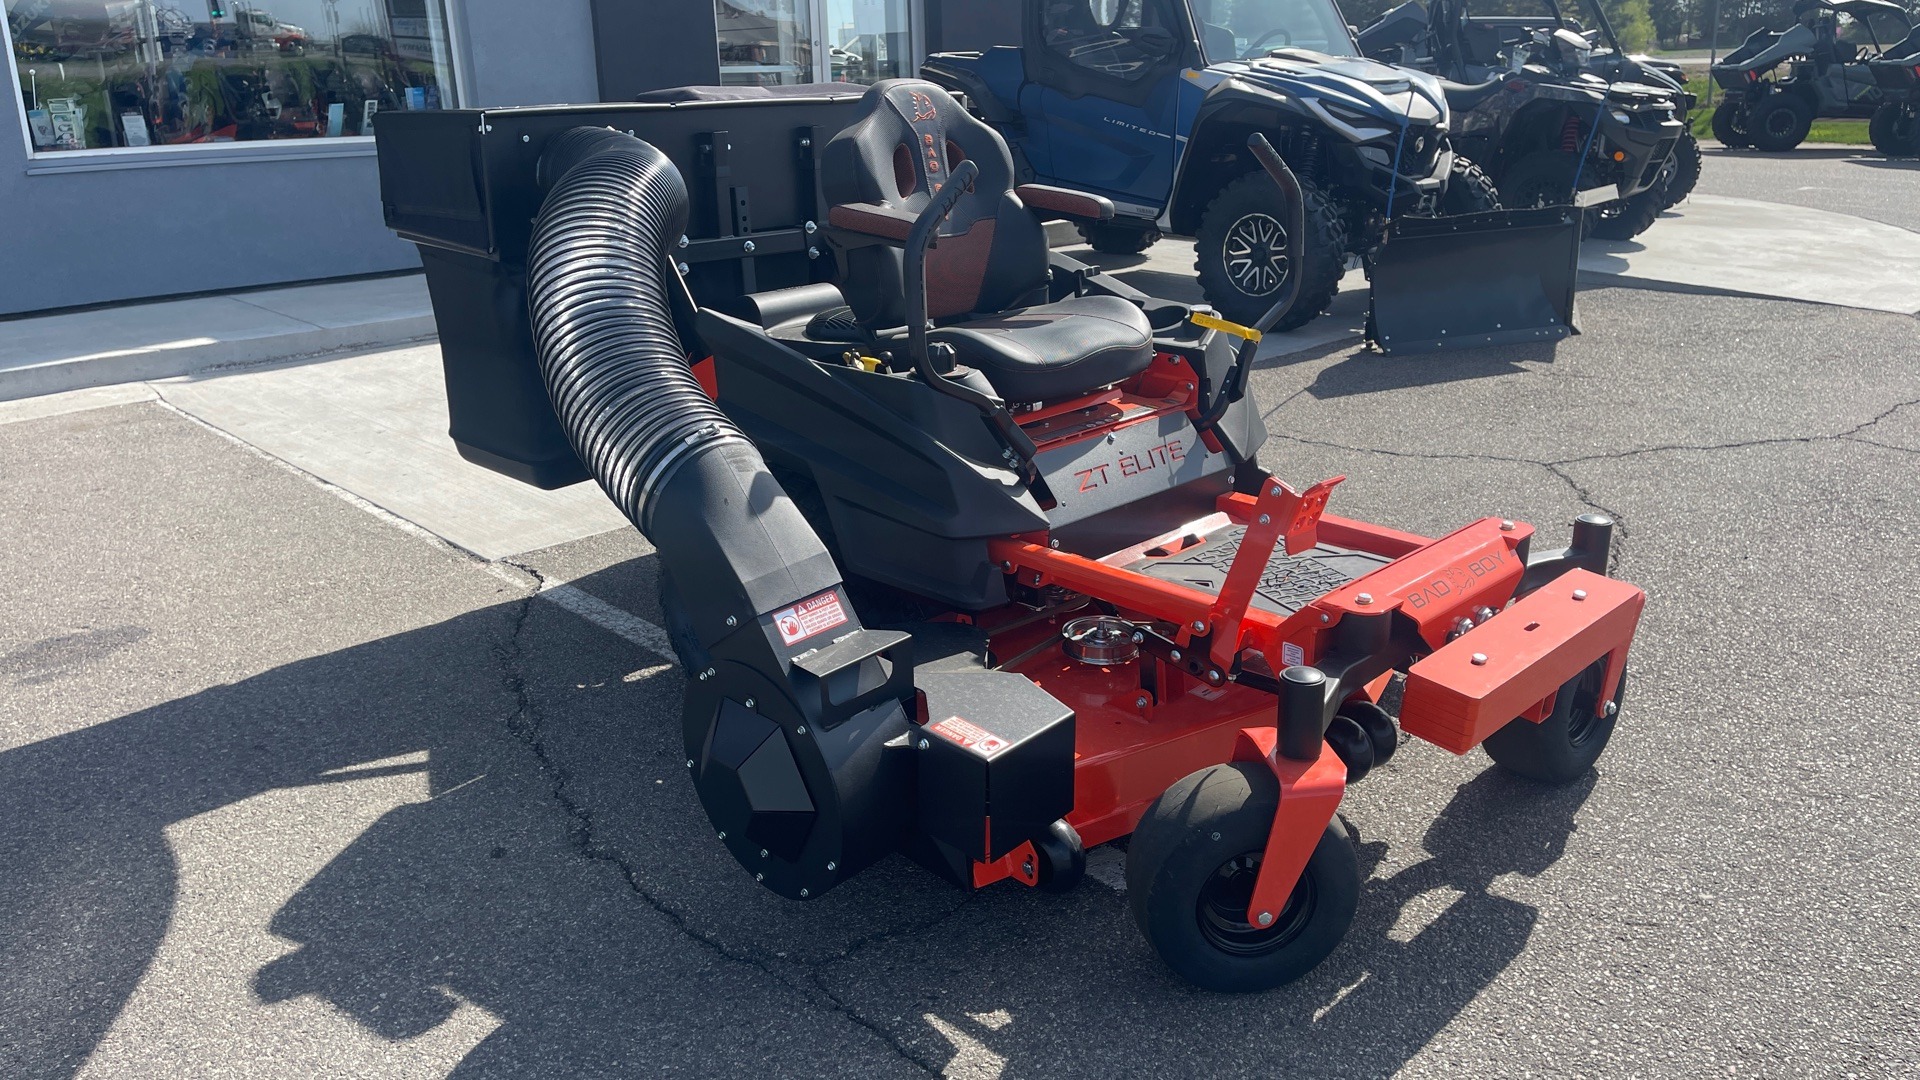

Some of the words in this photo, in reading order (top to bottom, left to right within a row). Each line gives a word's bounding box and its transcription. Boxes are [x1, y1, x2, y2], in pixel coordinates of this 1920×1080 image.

[1103, 116, 1157, 136] LIMITED
[924, 133, 939, 173] BAD
[1074, 463, 1110, 494] ZT
[1118, 440, 1186, 478] ELITE
[1407, 580, 1451, 609] BAD
[1468, 550, 1505, 577] BOY
[806, 593, 836, 611] DANGER
